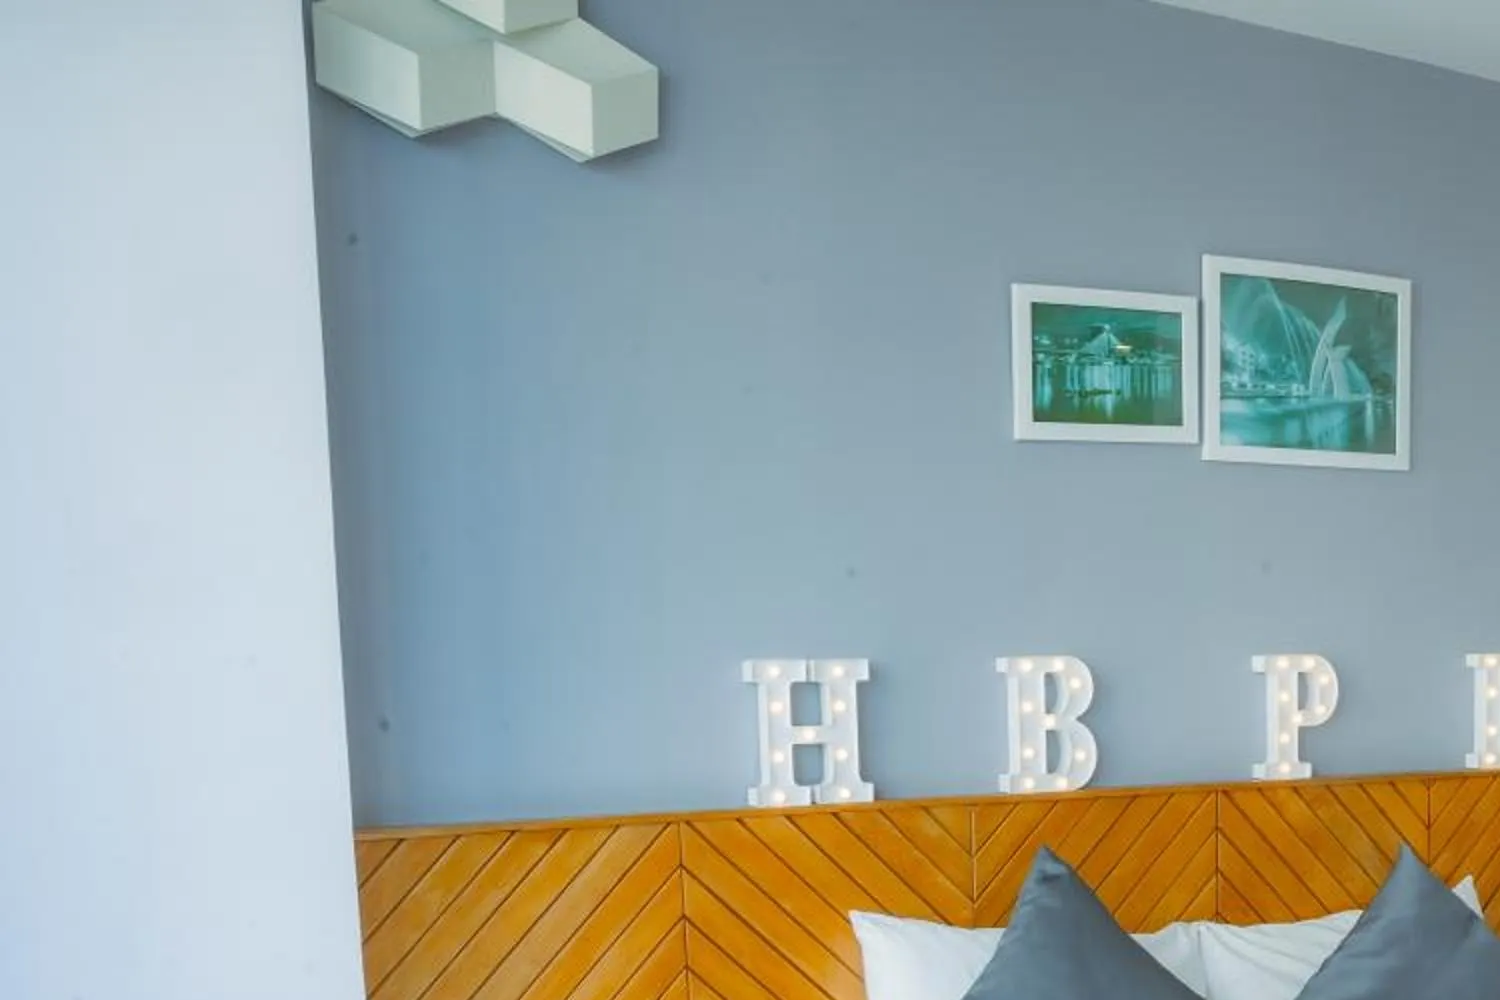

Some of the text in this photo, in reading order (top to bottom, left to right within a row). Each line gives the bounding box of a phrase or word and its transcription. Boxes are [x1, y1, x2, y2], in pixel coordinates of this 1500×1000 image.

[742, 658, 875, 807] H
[996, 655, 1098, 794] B
[1252, 654, 1339, 780] P
